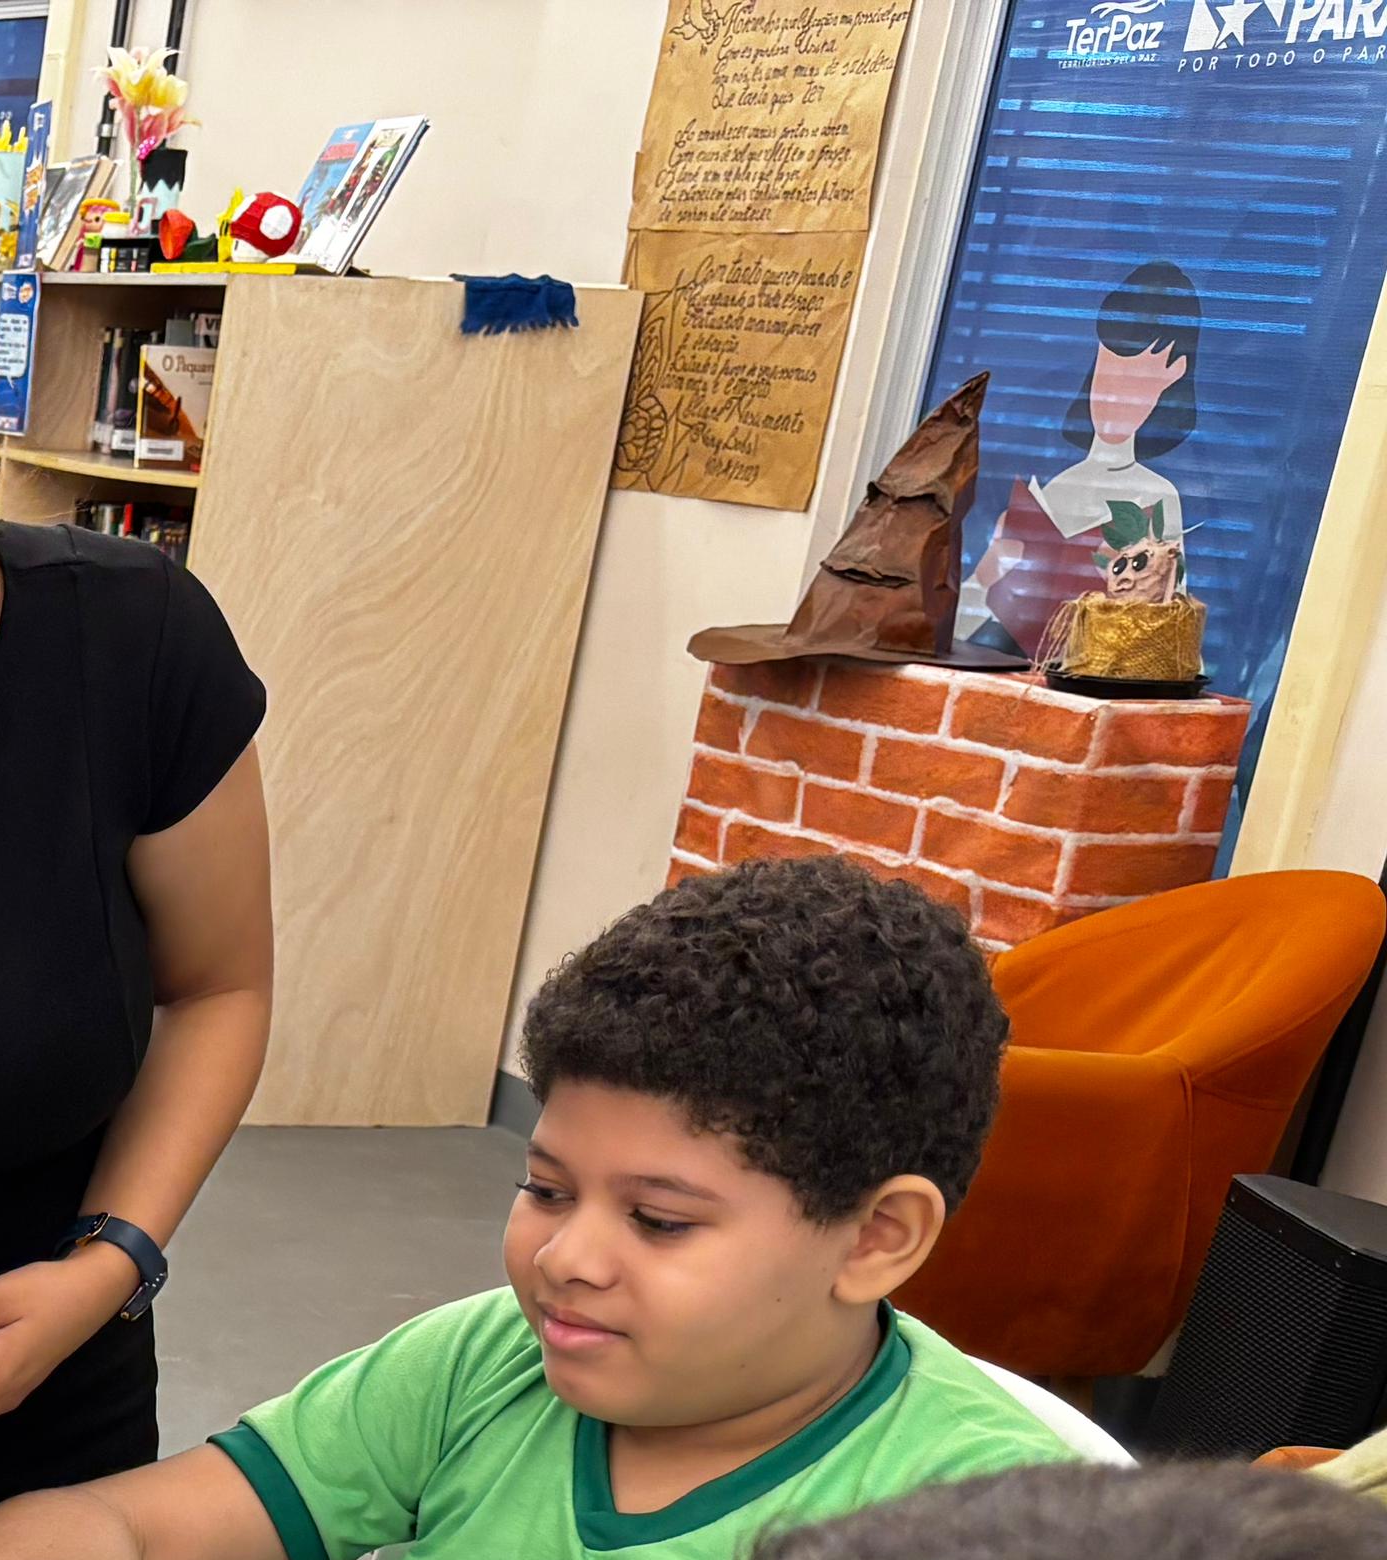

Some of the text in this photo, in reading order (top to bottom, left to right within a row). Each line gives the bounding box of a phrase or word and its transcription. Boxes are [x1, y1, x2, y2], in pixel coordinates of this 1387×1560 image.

[1066, 14, 1165, 56] TerPaz
[1285, 0, 1387, 43] PAR
[1178, 55, 1219, 72] POR
[1235, 50, 1296, 69] TODO
[1313, 48, 1325, 63] O
